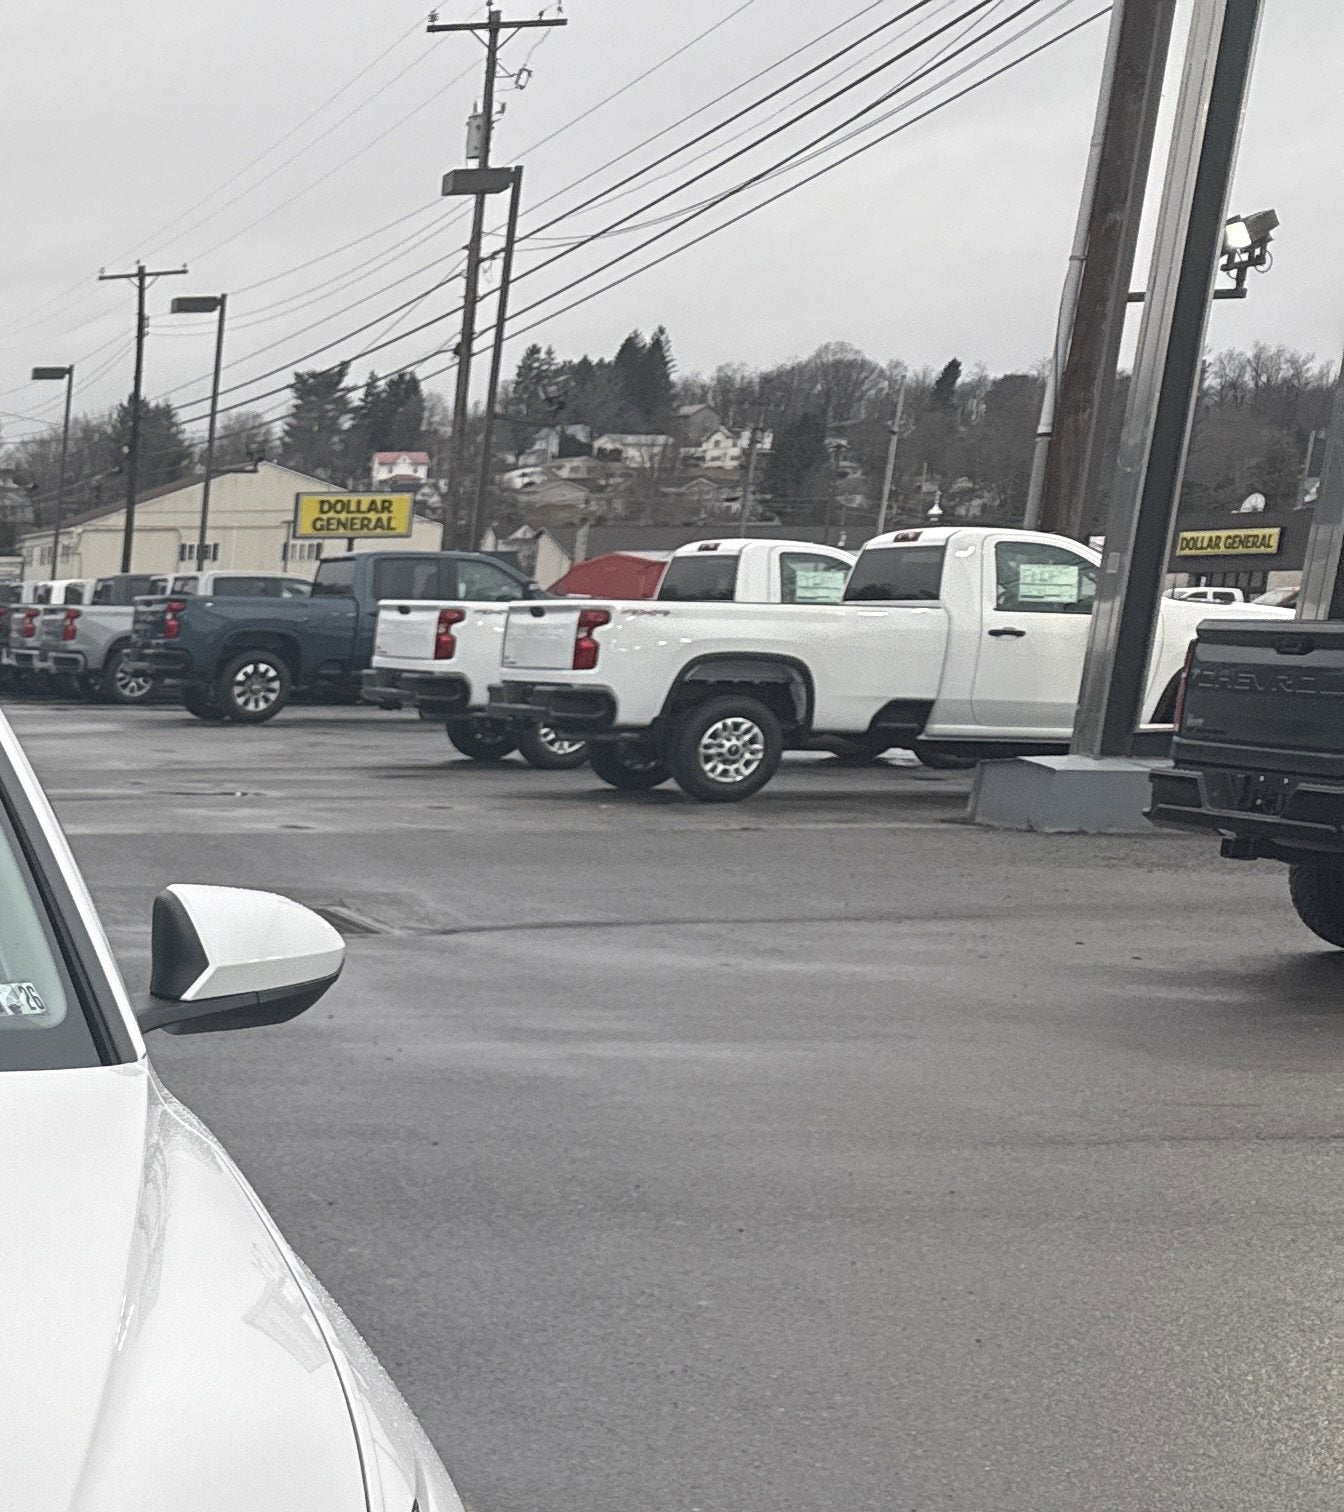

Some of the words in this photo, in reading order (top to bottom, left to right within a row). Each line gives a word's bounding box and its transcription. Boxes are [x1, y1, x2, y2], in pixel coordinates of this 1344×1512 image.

[319, 499, 393, 514] DOLLAR
[312, 517, 396, 531] GENERAL
[1179, 535, 1221, 550] DOLLAR
[1224, 533, 1273, 549] GENERAL
[18, 985, 45, 1011] 26
